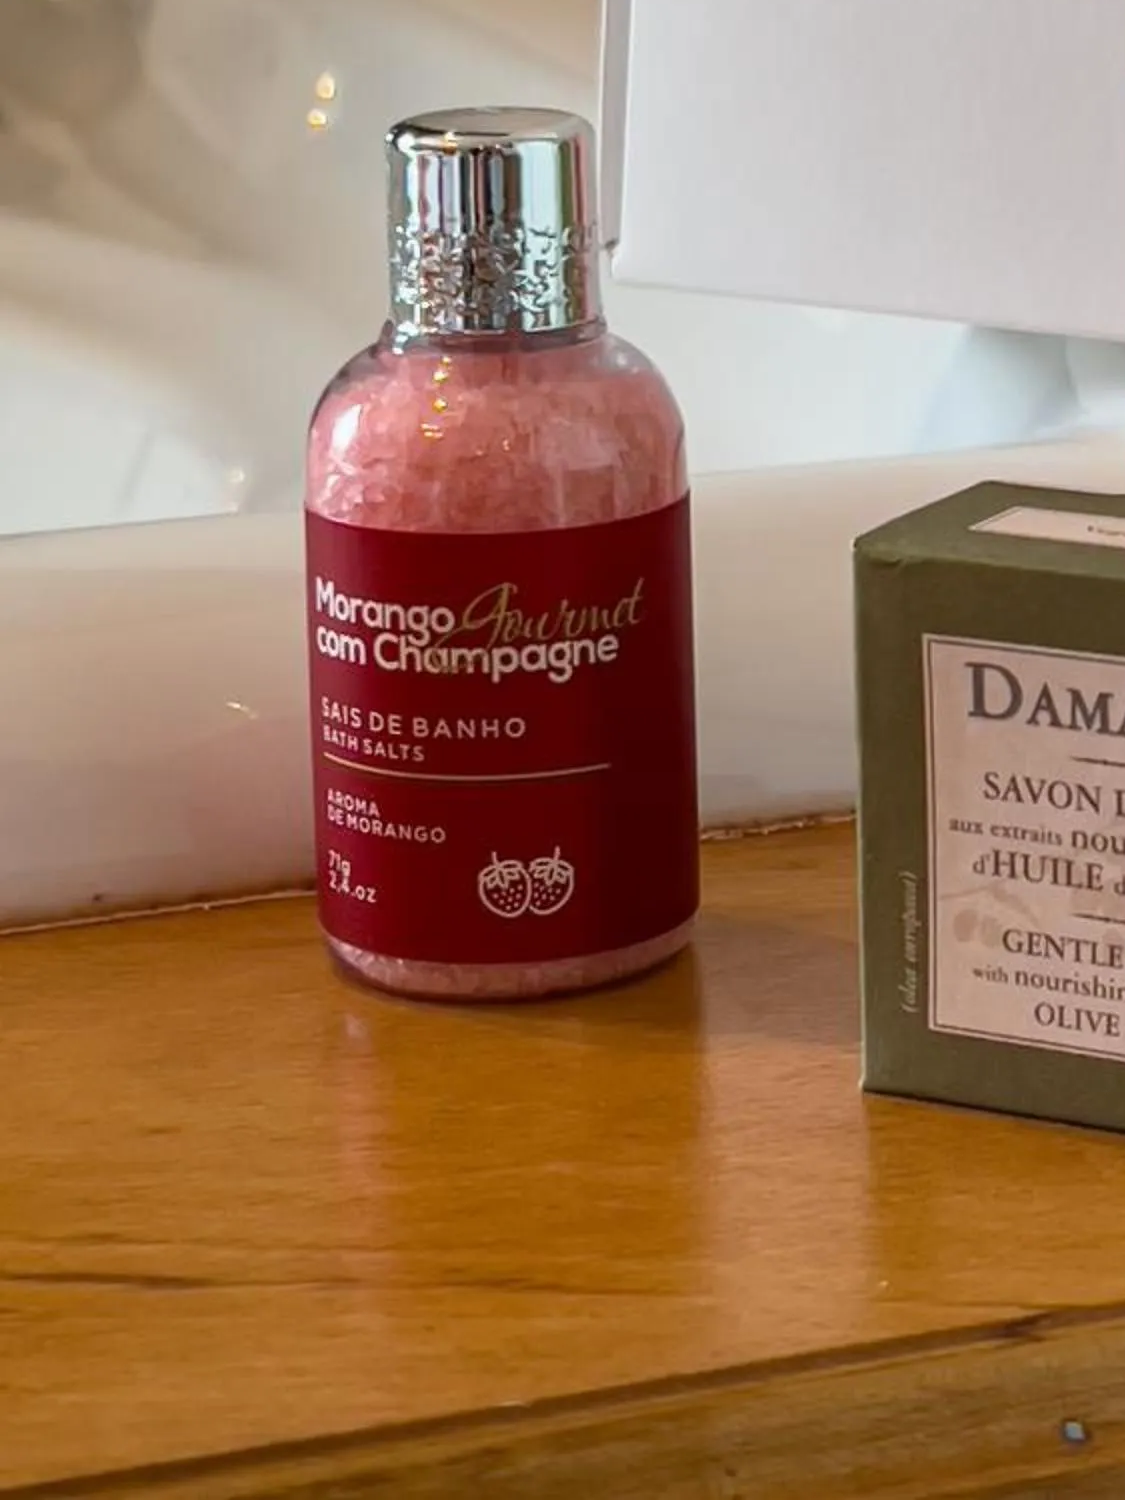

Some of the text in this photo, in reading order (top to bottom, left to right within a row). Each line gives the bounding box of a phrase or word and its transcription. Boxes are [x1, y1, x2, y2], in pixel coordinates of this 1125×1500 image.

[315, 576, 456, 647] Morango
[316, 626, 620, 683] com Champagne
[322, 696, 526, 740] SAIS DE BANHO
[323, 724, 426, 762] BATH SALTS
[327, 788, 380, 818] AROMA
[983, 771, 1101, 815] SAVON
[327, 805, 447, 844] DE MORANGO
[948, 816, 984, 836] aux
[990, 822, 1063, 847] extraits
[973, 848, 1104, 891] d'HUILE
[1002, 928, 1125, 970] GENTLE
[972, 965, 1009, 985] with
[1034, 1001, 1121, 1037] OLIVE
